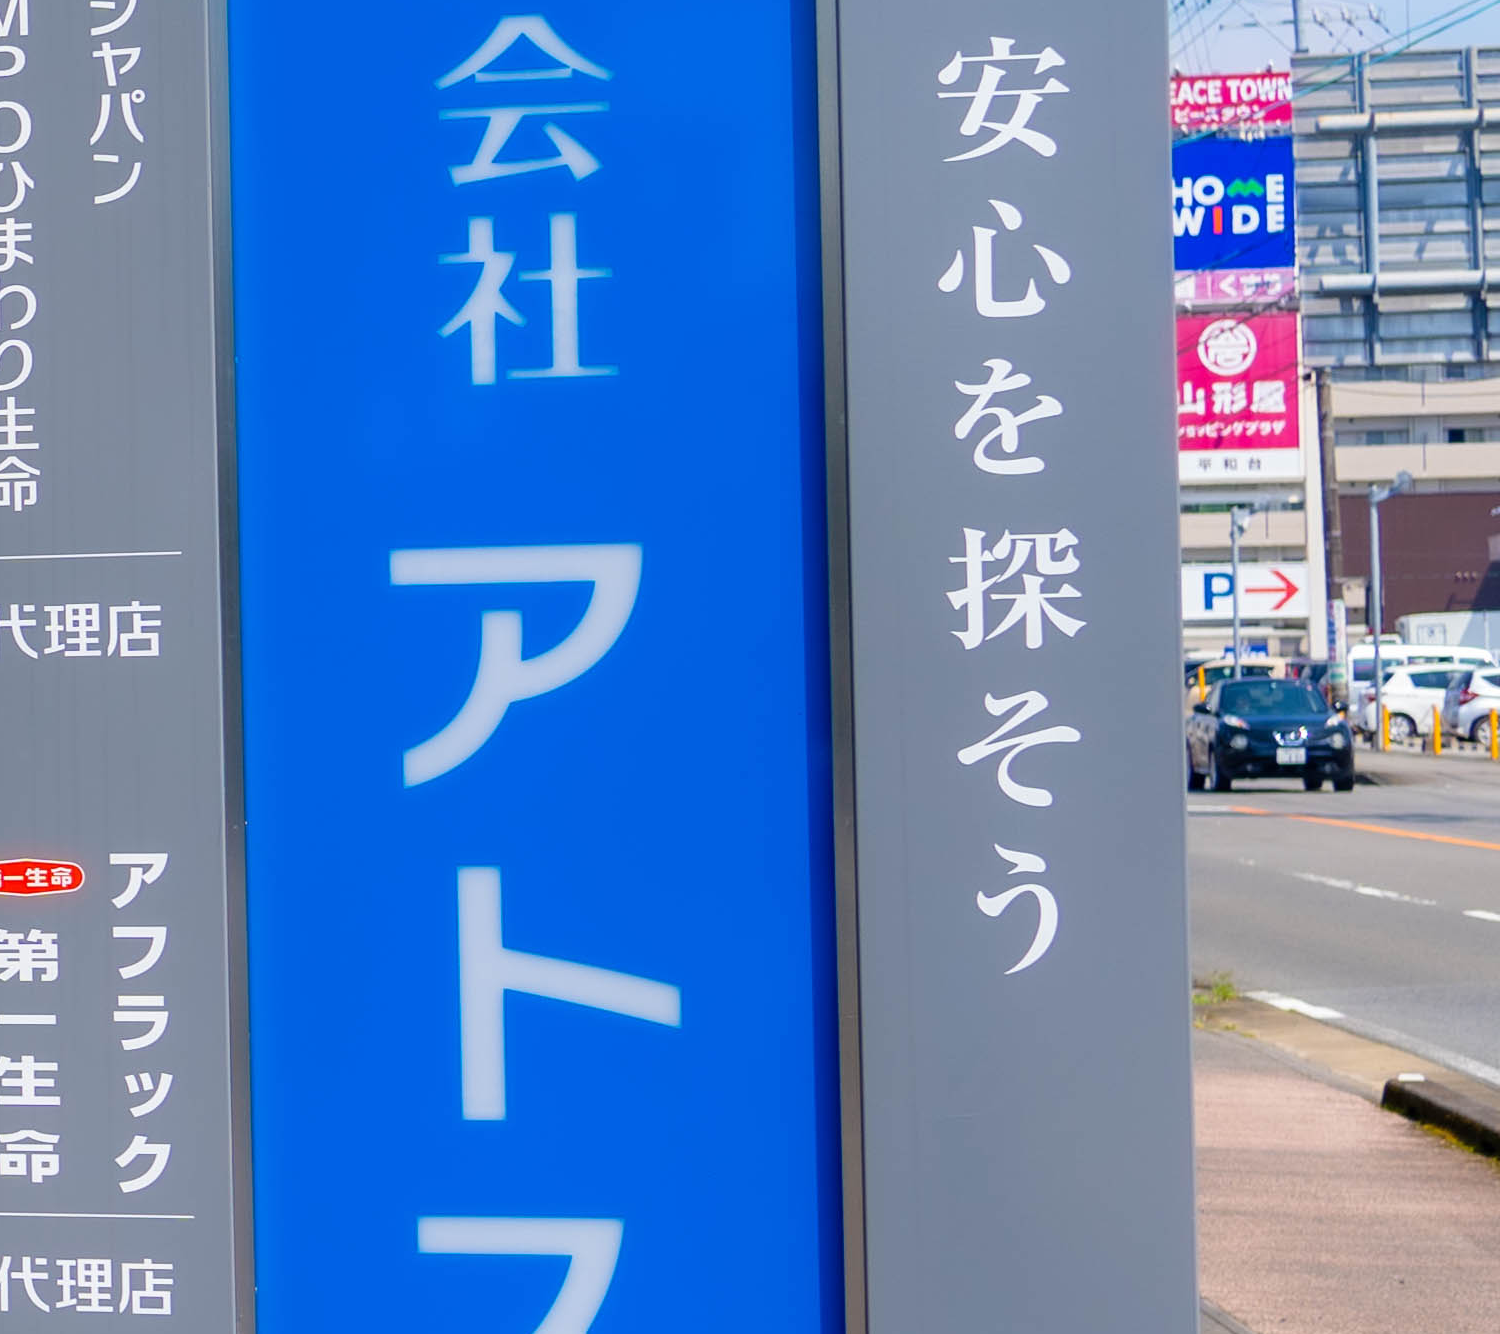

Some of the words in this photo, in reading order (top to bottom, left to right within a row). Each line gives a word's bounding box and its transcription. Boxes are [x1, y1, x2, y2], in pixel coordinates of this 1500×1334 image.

[1226, 76, 1291, 103] TOWN
[1173, 204, 1285, 237] WIDE
[1177, 380, 1286, 415] 山形屋
[1203, 573, 1235, 610] P
[110, 853, 172, 1193] アフラック
